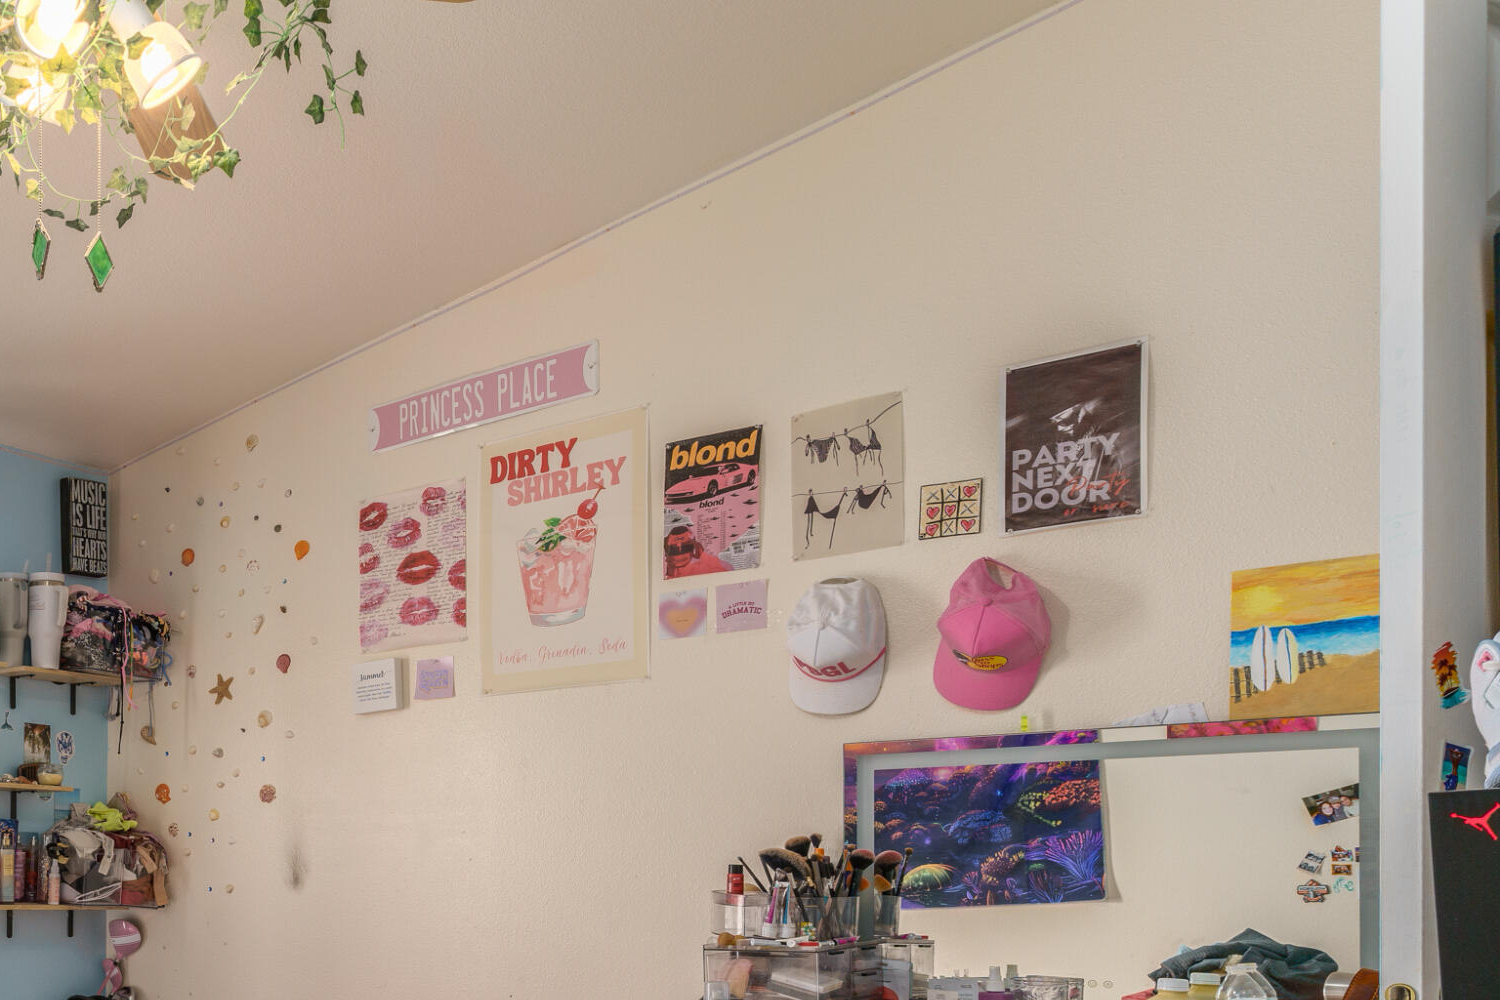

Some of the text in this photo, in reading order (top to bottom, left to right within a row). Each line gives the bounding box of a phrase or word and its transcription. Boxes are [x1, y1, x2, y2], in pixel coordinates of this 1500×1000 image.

[398, 358, 558, 440] PRINCESS PLACE
[490, 437, 578, 485] DIRTY
[670, 429, 758, 471] blond
[1012, 432, 1120, 471] PARTY
[507, 456, 627, 507] SHIRLEY
[1012, 459, 1097, 492] NEXT
[71, 479, 106, 507] MUSIC
[699, 497, 725, 509] blond
[1012, 480, 1111, 514] DOOR
[73, 503, 106, 530] IS LIFE
[73, 537, 107, 560] HEARTS
[721, 606, 762, 619] DRAMATIC
